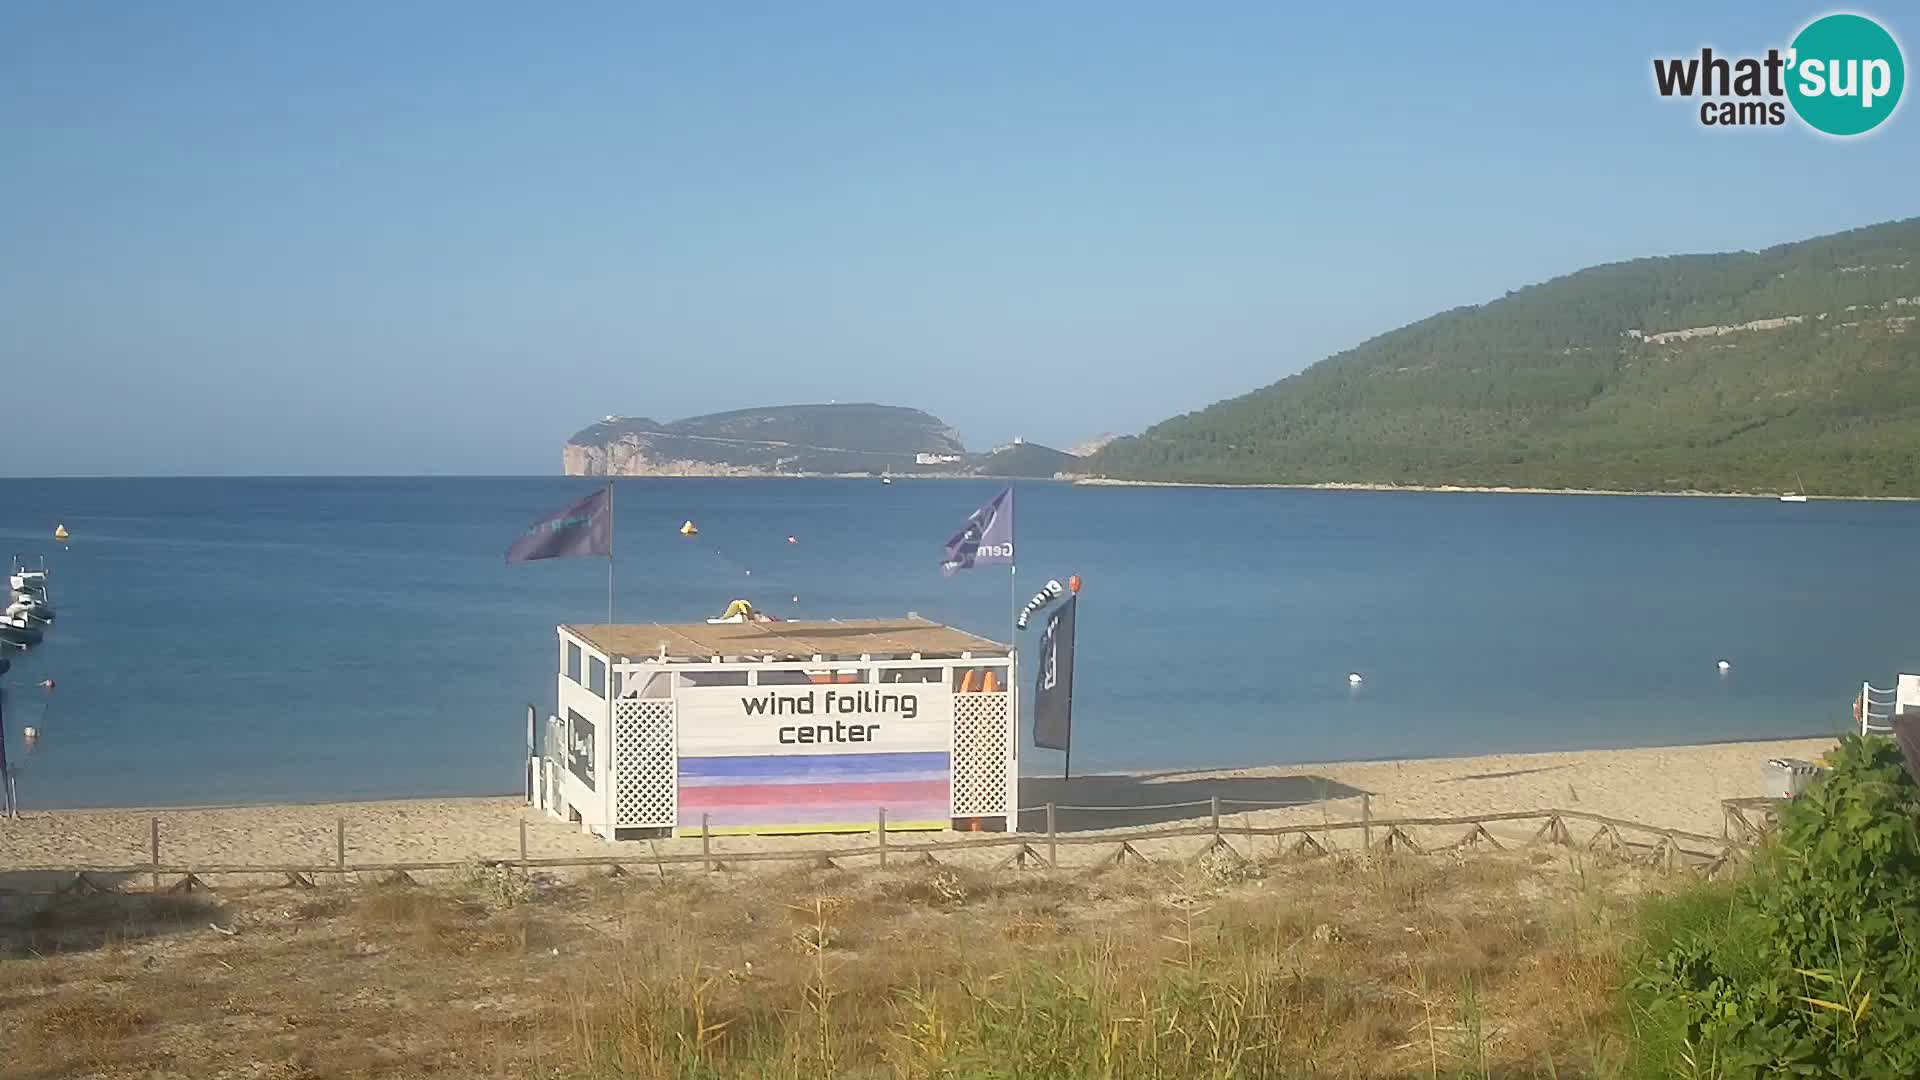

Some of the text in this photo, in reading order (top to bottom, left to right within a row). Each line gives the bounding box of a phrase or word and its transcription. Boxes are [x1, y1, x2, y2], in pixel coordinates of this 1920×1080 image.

[741, 689, 917, 718] wind foiling
[779, 720, 880, 744] center
